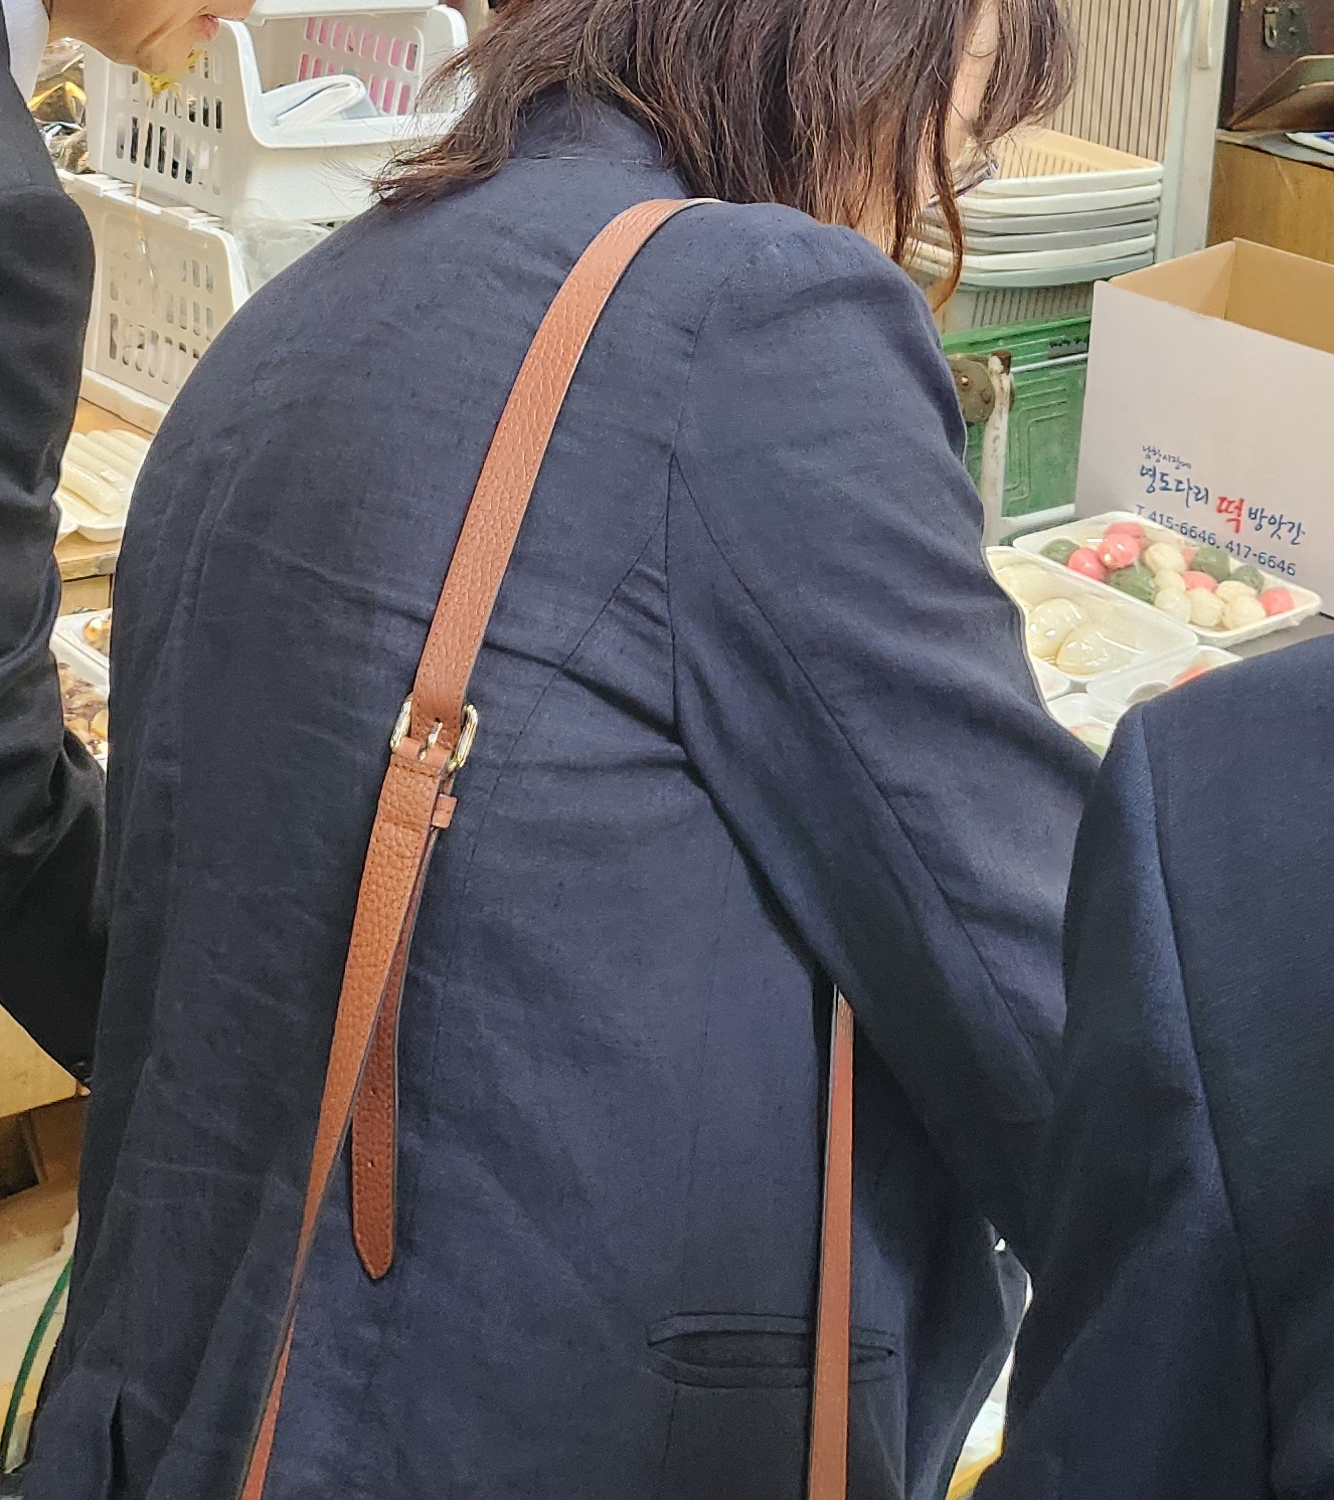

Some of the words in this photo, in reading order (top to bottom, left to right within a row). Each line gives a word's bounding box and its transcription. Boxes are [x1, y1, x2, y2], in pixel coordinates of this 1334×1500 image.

[1139, 464, 1210, 508] 영도다리
[1216, 495, 1245, 534] 떡
[1248, 507, 1306, 545] 방앗간
[1225, 540, 1297, 577] 417-6646
